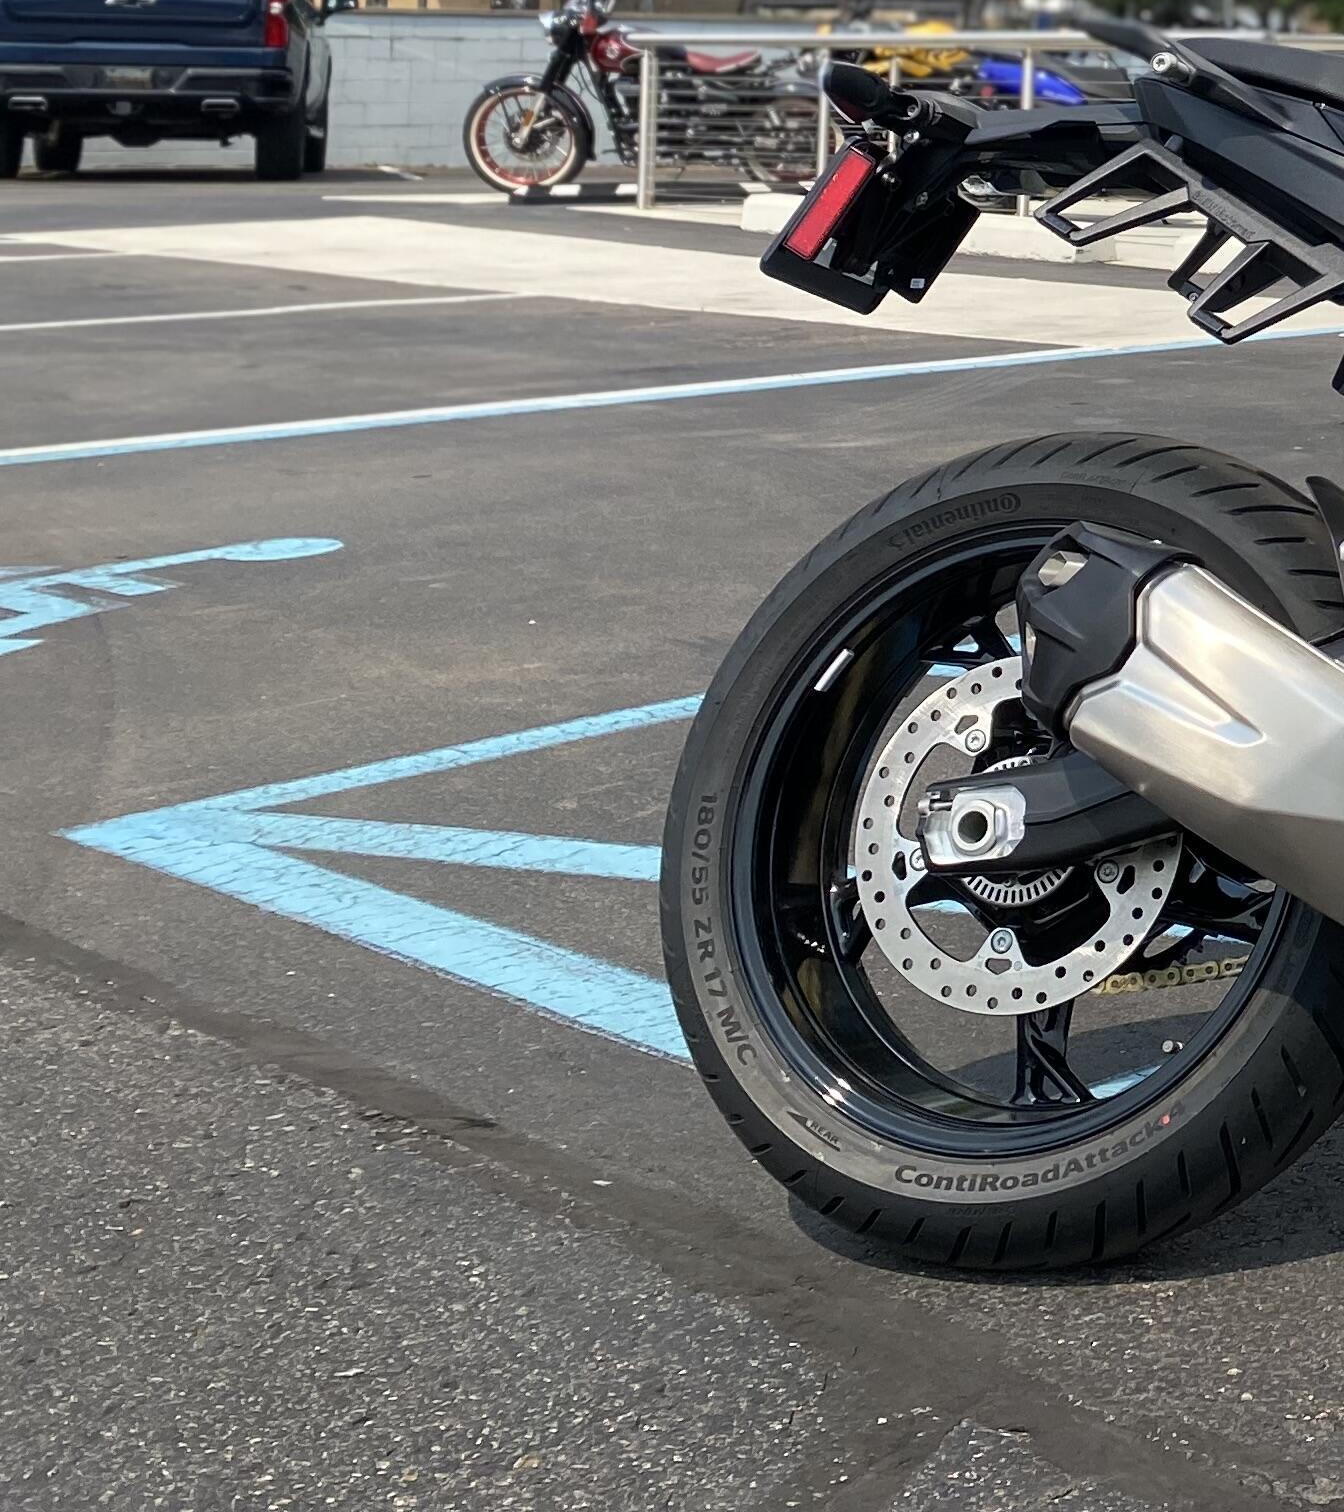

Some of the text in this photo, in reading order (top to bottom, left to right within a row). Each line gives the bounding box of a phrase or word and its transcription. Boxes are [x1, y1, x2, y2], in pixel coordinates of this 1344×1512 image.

[902, 491, 1023, 546] Continental
[690, 792, 718, 906] 180/55
[716, 1007, 759, 1067] M/C
